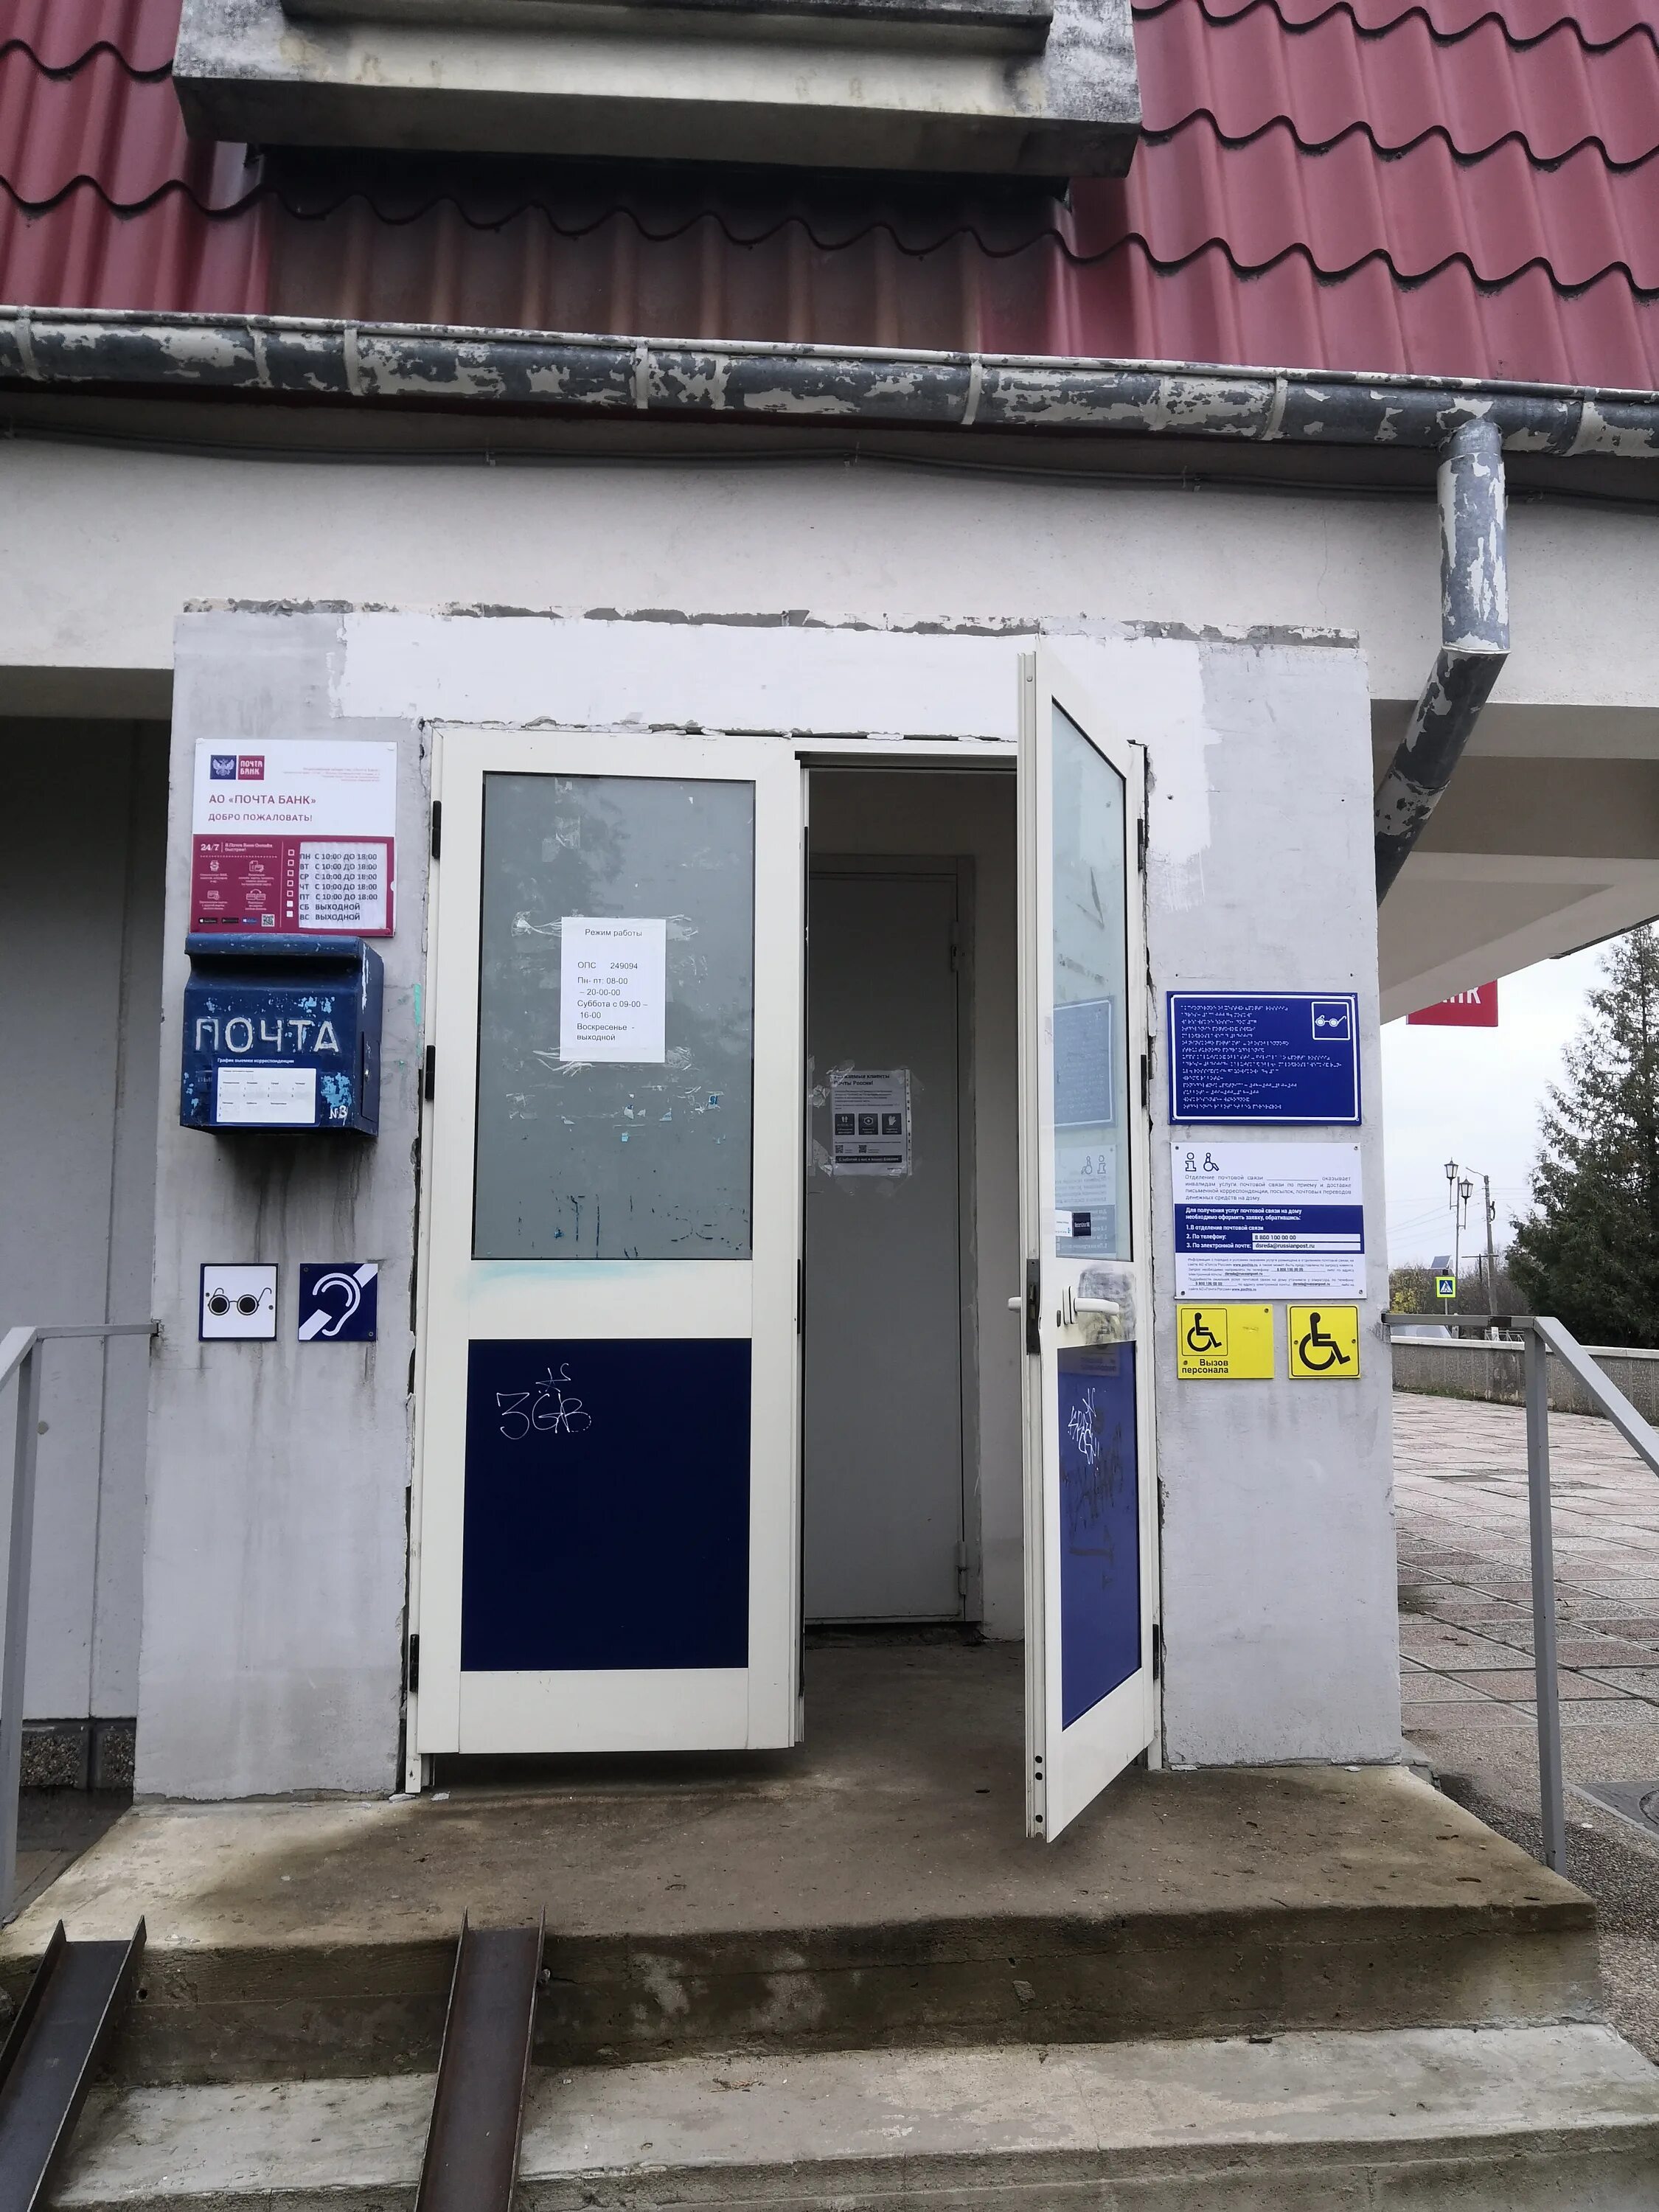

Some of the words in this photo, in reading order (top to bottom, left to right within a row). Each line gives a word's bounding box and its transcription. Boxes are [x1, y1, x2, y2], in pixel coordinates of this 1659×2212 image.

[240, 759, 263, 768] ПОЧТА
[209, 794, 225, 804] АО
[229, 794, 275, 804] «ПОЧТА
[278, 795, 316, 804] БАНК»
[208, 813, 240, 822] ДОБРО
[243, 813, 313, 822] ПОЖАЛОВАТЬ!
[343, 853, 355, 861] ДО
[343, 863, 355, 872] ДО
[343, 874, 355, 882] ДО
[343, 883, 355, 891] ДО
[315, 902, 361, 911] ВЫХОДНОЙ
[315, 913, 361, 921] ВЫХОДНОЙ
[586, 988, 621, 996] 20-00-00
[577, 1000, 611, 1009] Суббота
[577, 1023, 627, 1032] Воскресенье
[195, 1017, 339, 1053] ПОЧТА
[1200, 1358, 1229, 1366] Вызов
[1181, 1367, 1229, 1375] персонала
